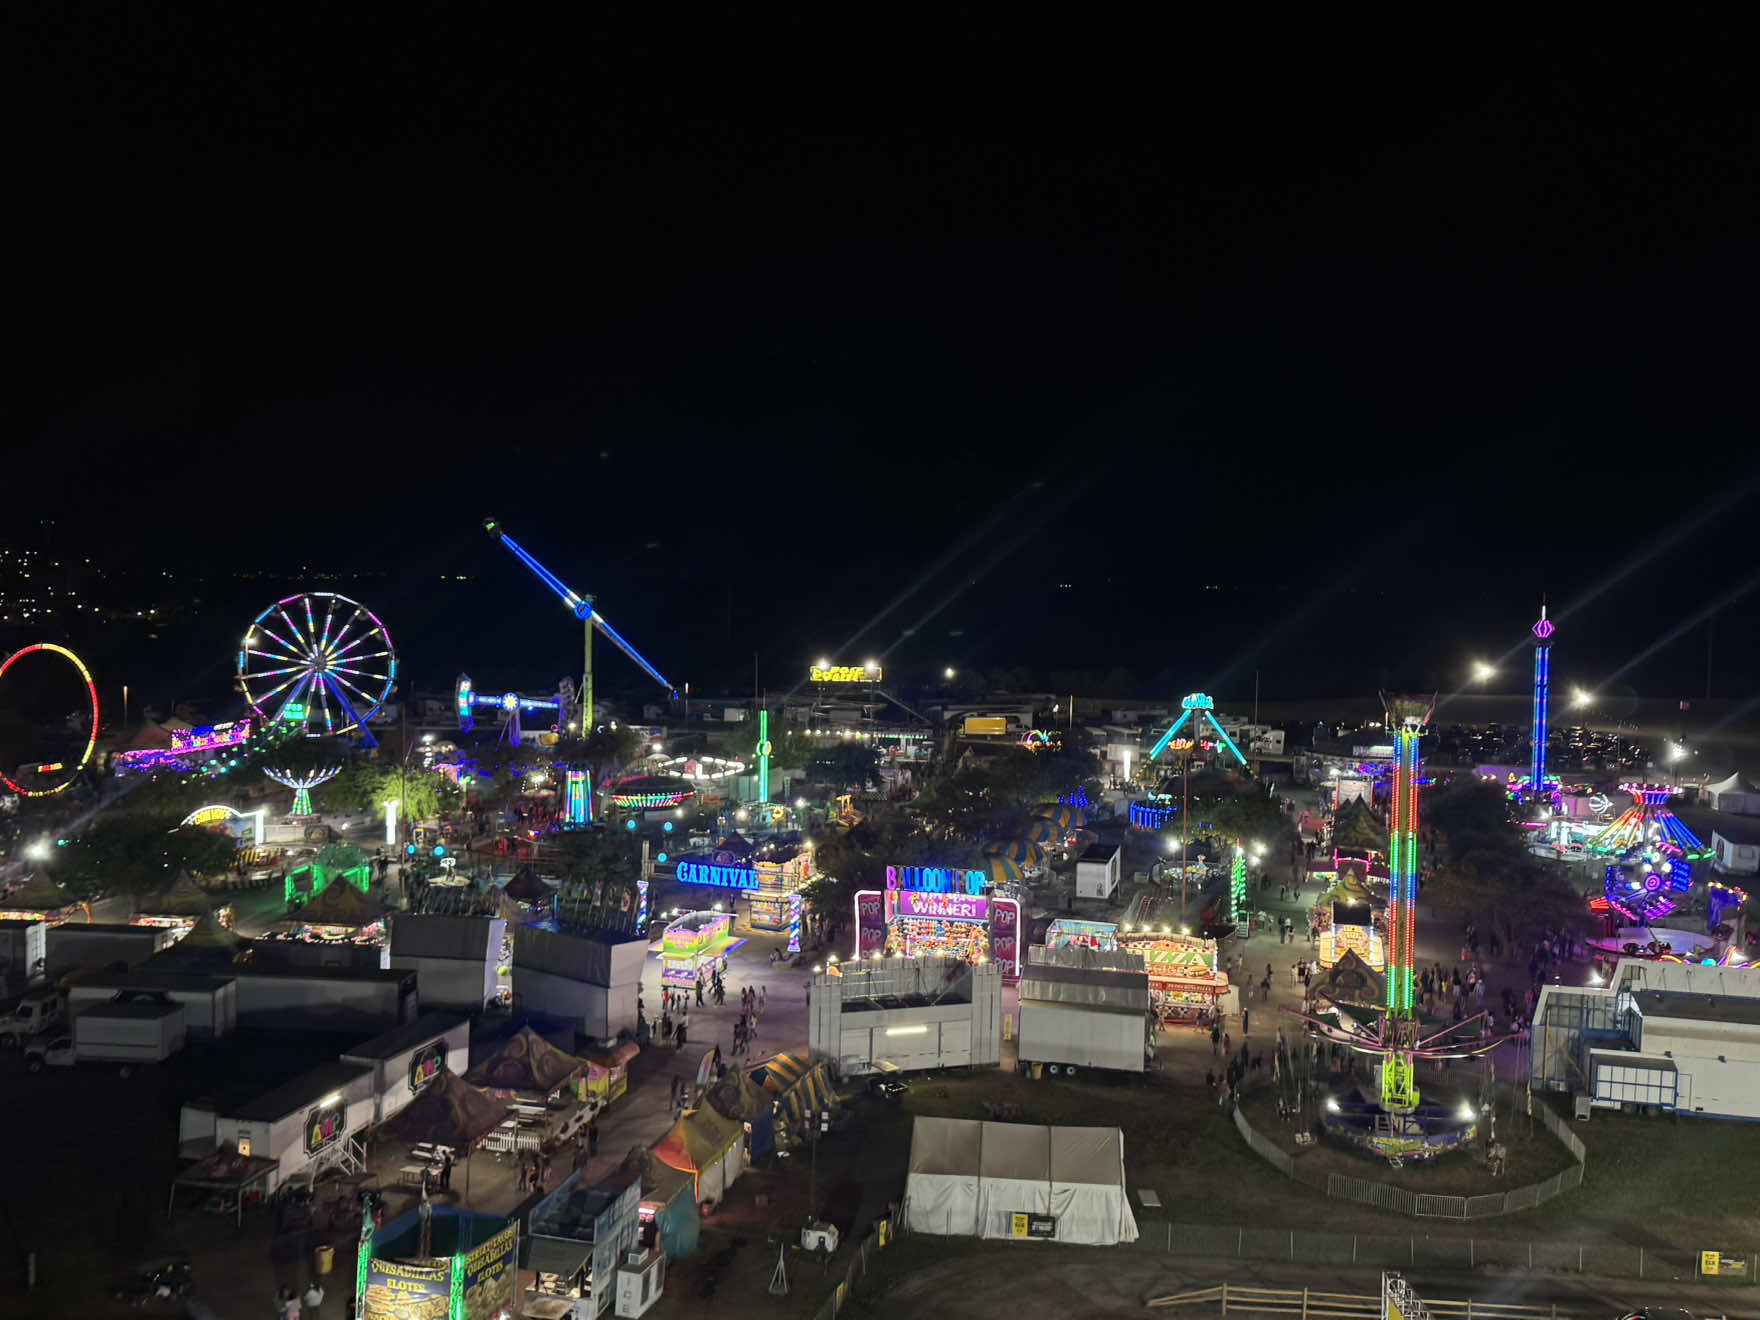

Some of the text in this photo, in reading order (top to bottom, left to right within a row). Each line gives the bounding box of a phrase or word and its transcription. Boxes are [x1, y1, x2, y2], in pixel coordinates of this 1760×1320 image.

[677, 861, 760, 890] CARNIVAL
[886, 866, 952, 893] BALLOON
[371, 1260, 445, 1282] QUESADILLAS
[387, 1279, 425, 1292] ELOTES
